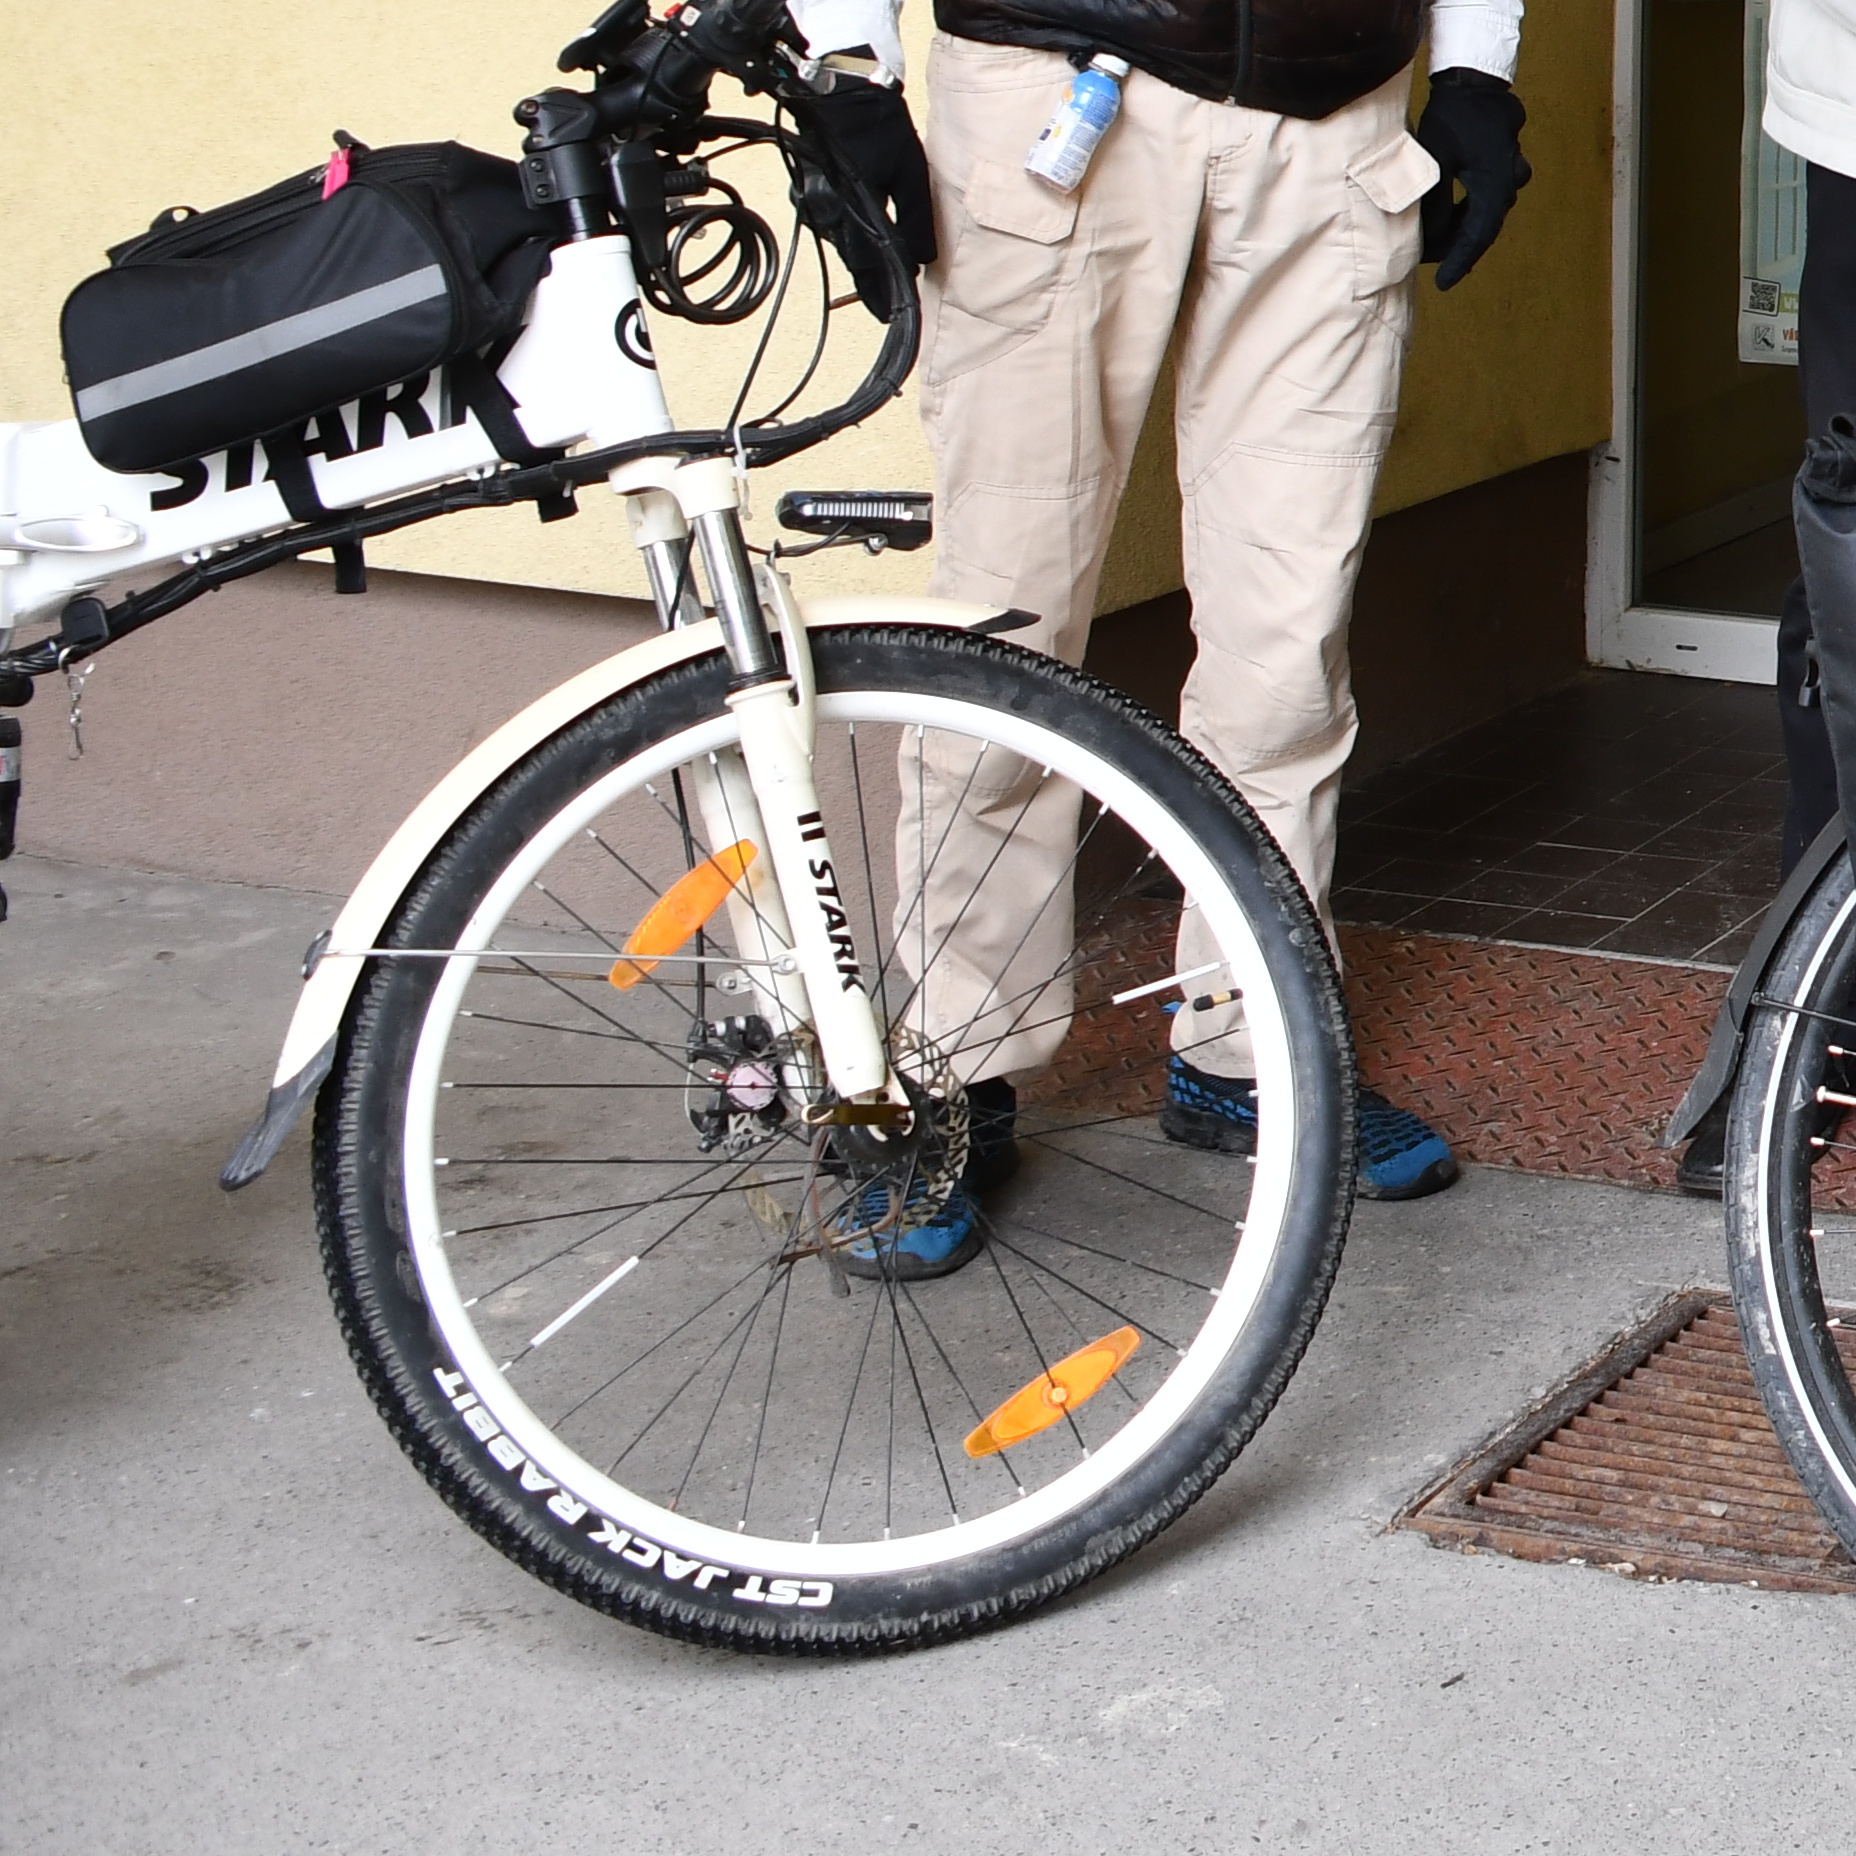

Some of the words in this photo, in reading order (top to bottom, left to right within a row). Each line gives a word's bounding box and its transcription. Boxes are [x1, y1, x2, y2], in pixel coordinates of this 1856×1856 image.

[808, 859, 868, 997] STARK
[432, 1366, 590, 1526] RABBIT
[587, 1518, 731, 1590] JACK
[732, 1576, 835, 1608] CST
